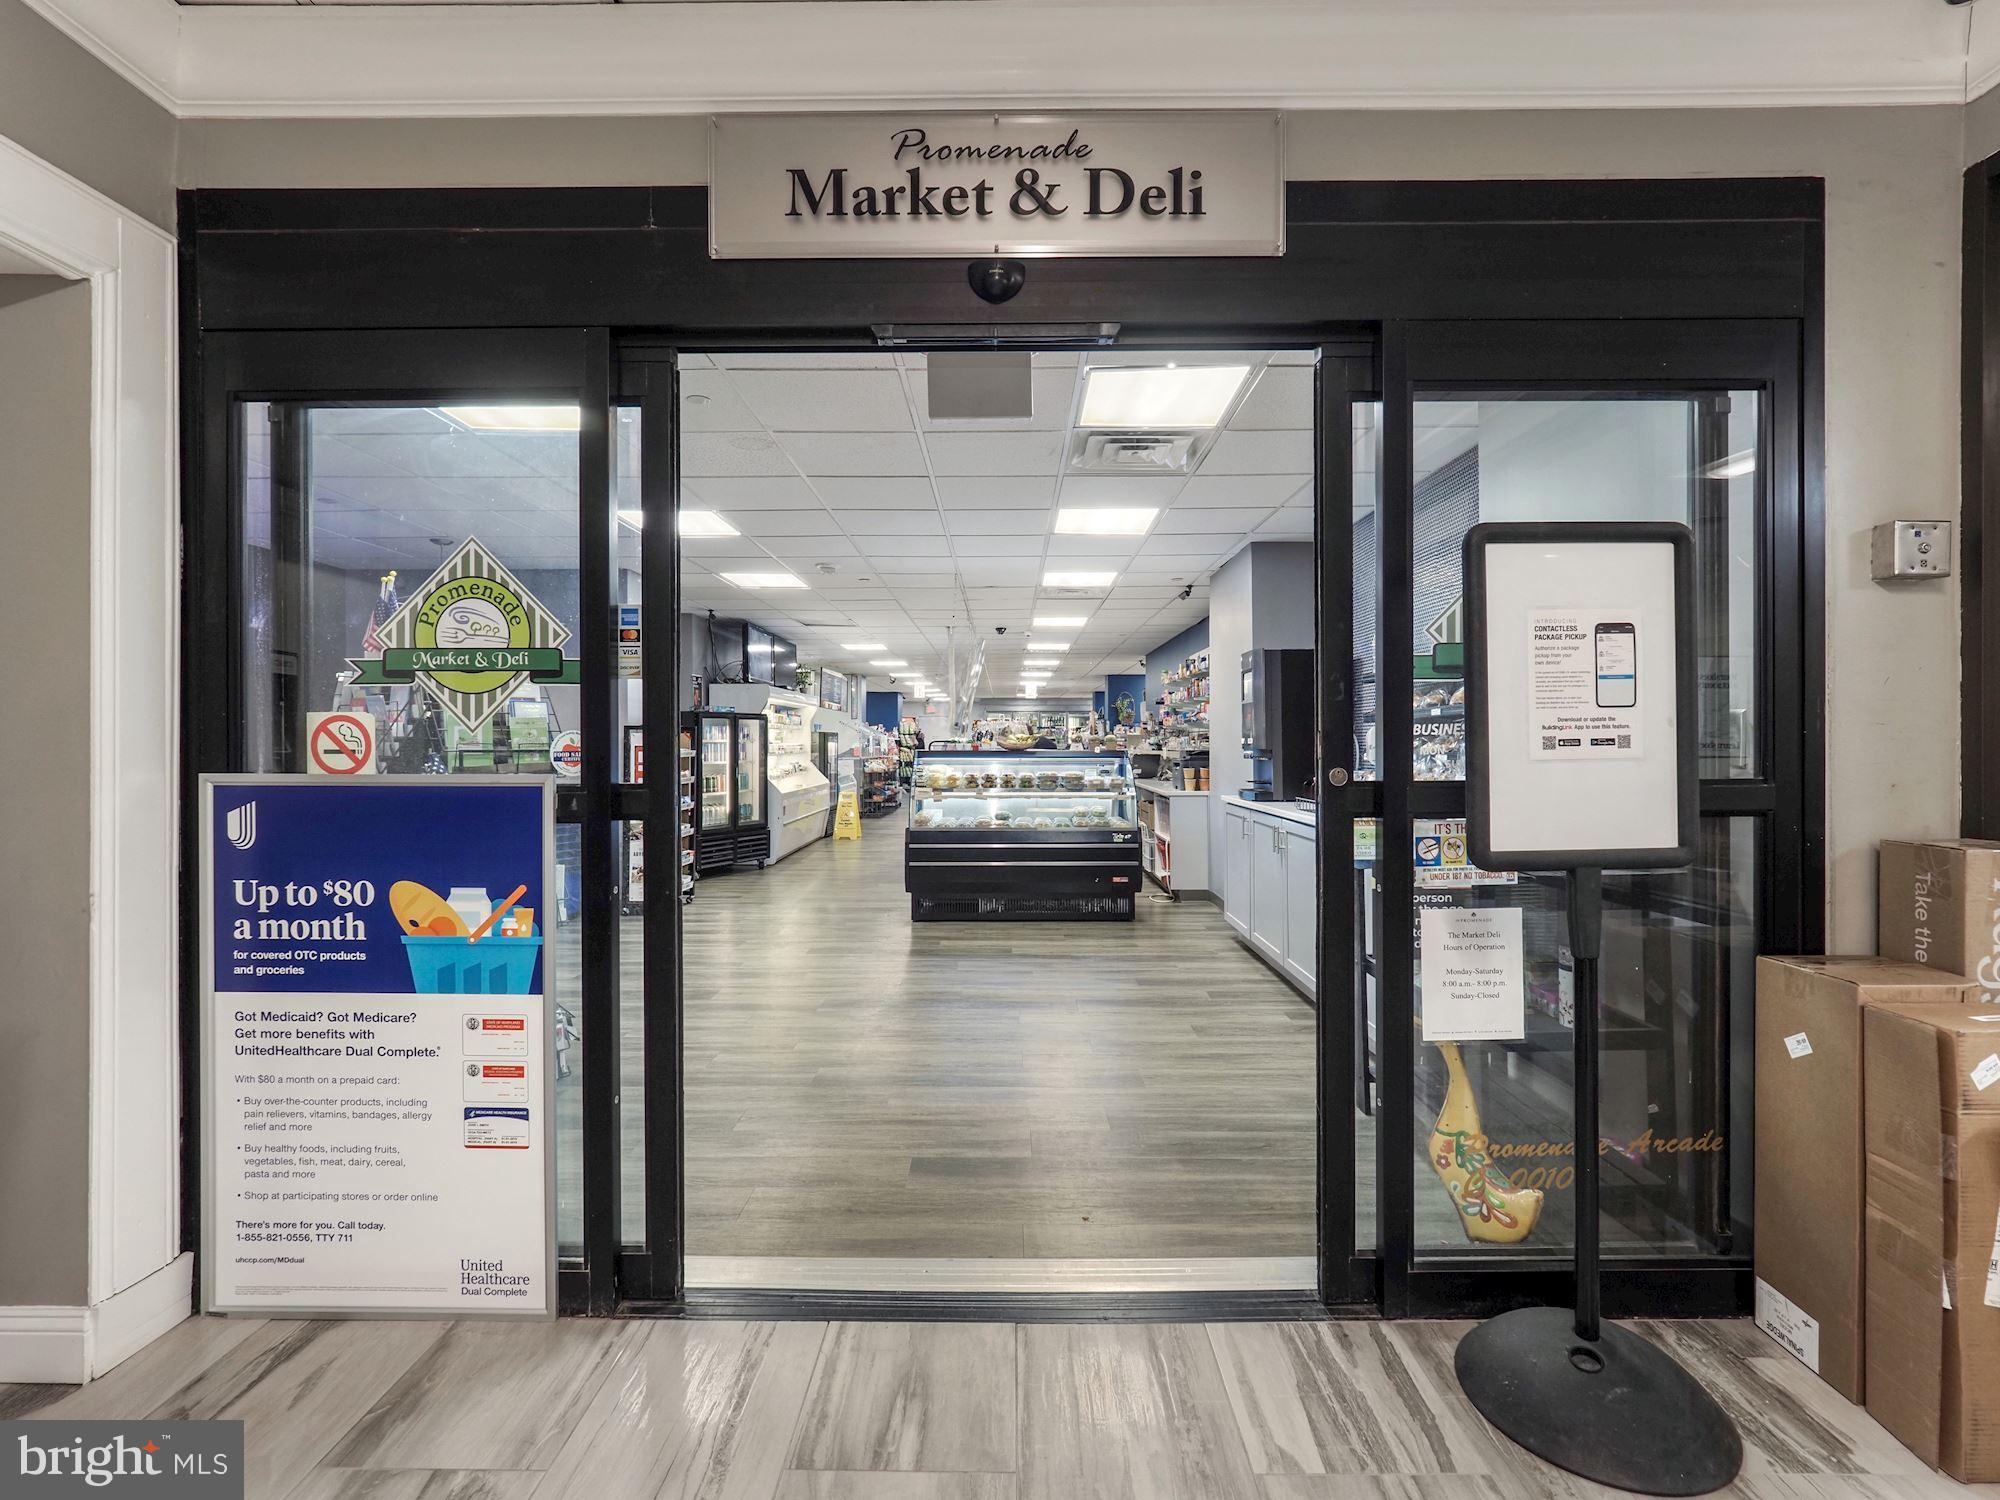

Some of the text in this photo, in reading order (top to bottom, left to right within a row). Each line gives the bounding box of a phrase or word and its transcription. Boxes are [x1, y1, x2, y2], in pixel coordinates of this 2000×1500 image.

[891, 129, 1093, 160] Promenade
[785, 167, 1206, 217] Market & Deli
[419, 583, 521, 627] Promenade
[413, 652, 529, 669] Market & Deli
[1413, 723, 1466, 736] BUSINE
[1434, 823, 1467, 835] IT'S TH
[1430, 872, 1450, 880] UNDER
[1452, 872, 1461, 880] 18?
[1464, 871, 1472, 879] NO
[233, 880, 374, 912] Up to $80
[1915, 872, 1932, 963] Take the
[234, 911, 367, 940] a month
[1474, 943, 1505, 951] Operation
[233, 950, 366, 962] for covered OTC products
[234, 965, 304, 976] and groceries
[1446, 968, 1503, 976] Monday-Saturday
[1451, 992, 1499, 1000] Sunday-Closed
[235, 1011, 416, 1022] Got Medicaid? Got Medicare?
[235, 1028, 256, 1038] Get
[296, 1029, 345, 1039] benefits
[349, 1029, 374, 1039] with
[235, 1045, 341, 1056] UnitedHealthcare
[346, 1046, 372, 1056] Dual
[235, 1075, 255, 1083] With
[258, 1075, 275, 1083] $80
[340, 1076, 374, 1085] prepaid
[244, 1097, 427, 1108] Buy over-the-counter products, including
[244, 1109, 432, 1121] pain relievers, vitamins, bandages, allergy
[244, 1122, 266, 1130] relief
[269, 1123, 286, 1131] and
[245, 1144, 399, 1155] Buy healthy foods, including fruits,
[1463, 1128, 1725, 1162] Promenae Arcade
[244, 1157, 296, 1167] vegetables,
[299, 1157, 317, 1166] fish,
[348, 1158, 372, 1168] dairy,
[376, 1159, 405, 1167] cereal,
[244, 1171, 269, 1179] pasta
[271, 1169, 289, 1178] and
[244, 1191, 268, 1201] Shop
[282, 1192, 339, 1202] participating
[384, 1193, 408, 1201] order
[411, 1193, 438, 1201] online
[300, 1221, 313, 1229] for
[338, 1221, 355, 1229] Call
[358, 1222, 385, 1231] today.
[237, 1233, 312, 1242] 1-855-821-0556,
[338, 1234, 352, 1242] 711
[461, 1259, 502, 1271] United
[462, 1273, 529, 1285] Healthcare
[462, 1287, 527, 1297] Dual Complete
